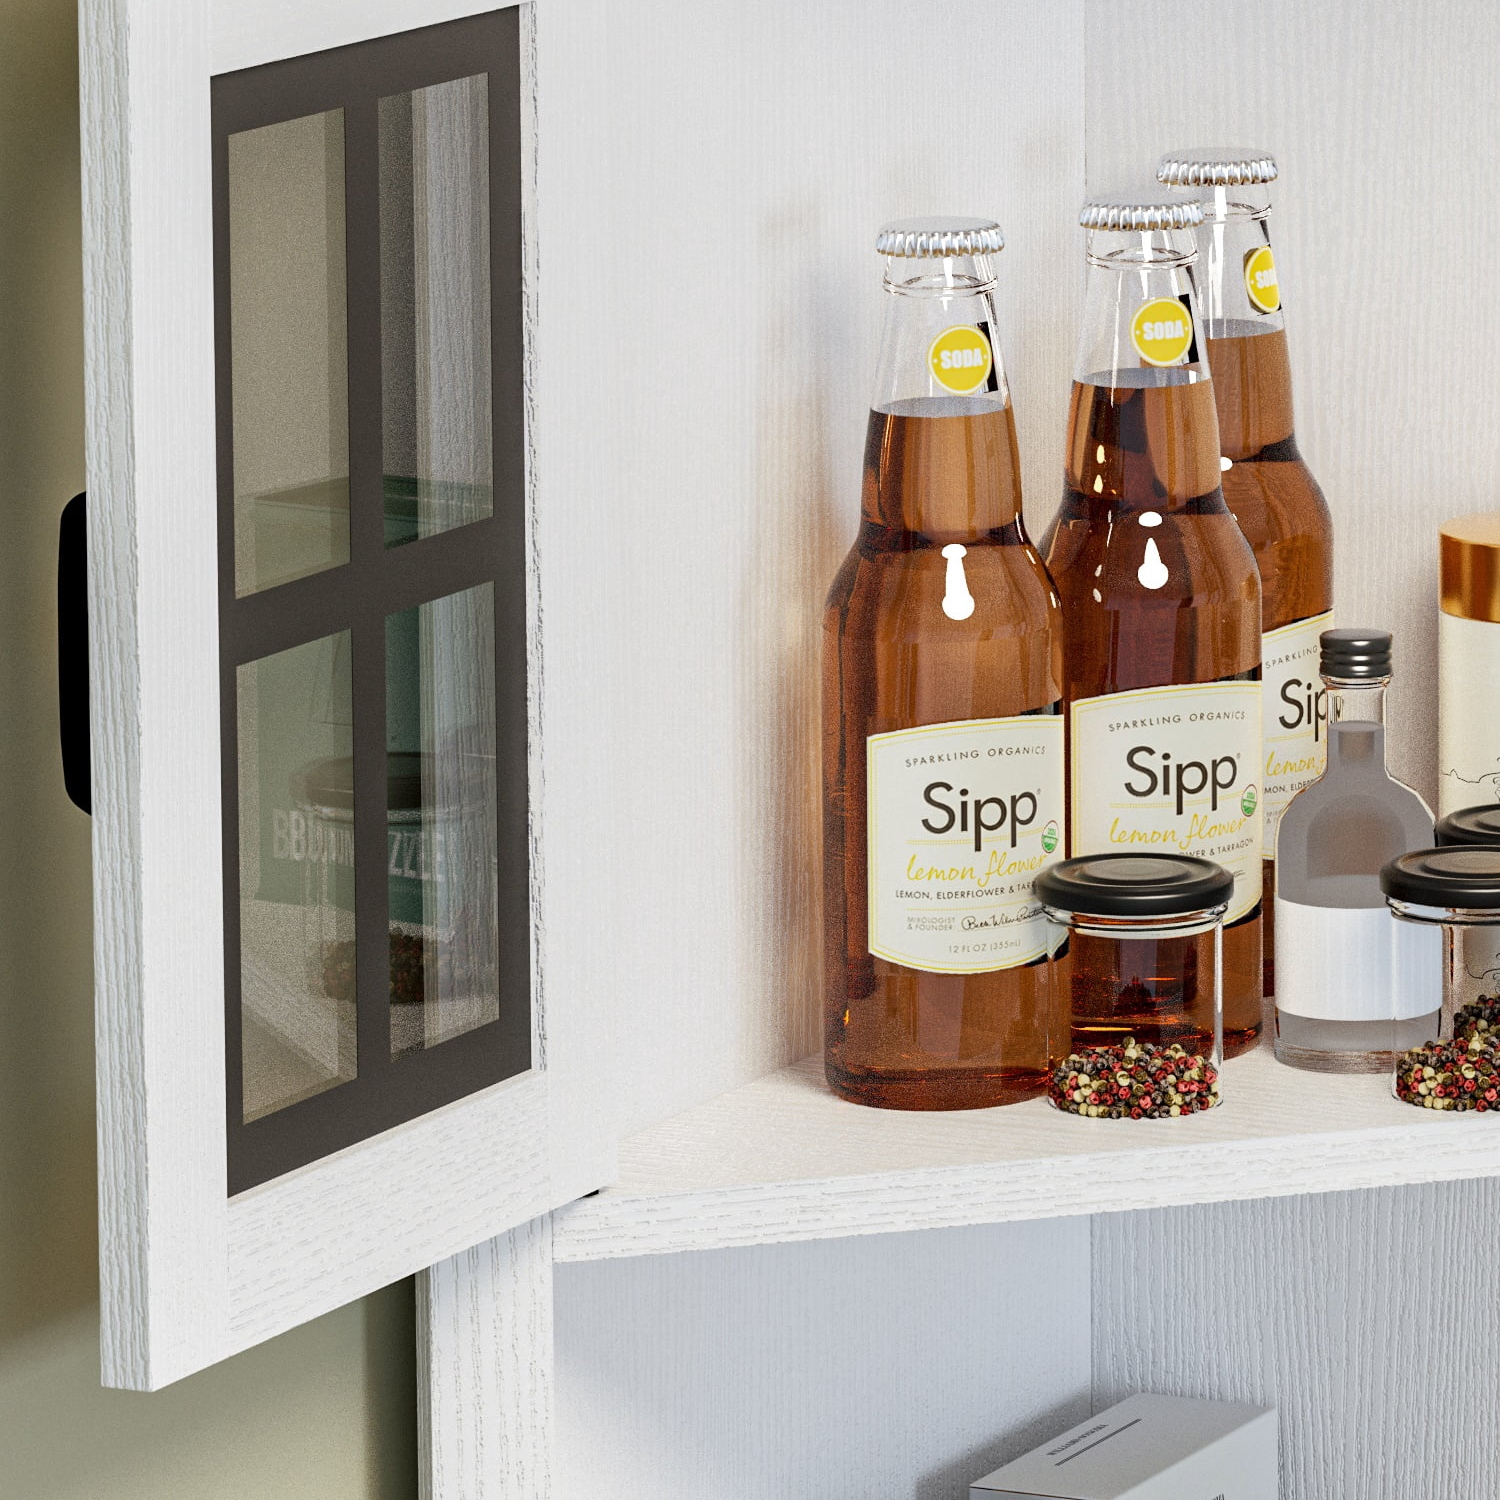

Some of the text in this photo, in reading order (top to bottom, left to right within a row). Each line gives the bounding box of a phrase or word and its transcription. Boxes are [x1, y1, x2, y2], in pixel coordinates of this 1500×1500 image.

[1142, 319, 1184, 341] SODA
[940, 347, 983, 369] SODA
[1265, 644, 1318, 670] SPARKLING
[1108, 710, 1246, 732] SPARKLING ORGANICS
[1278, 678, 1327, 743] Sip
[905, 745, 1047, 768] SPARKLING ORGANICS
[1265, 750, 1315, 777] lemon
[1124, 745, 1237, 816] Sipp
[921, 781, 1038, 853] Sipp
[1109, 817, 1178, 844] lemon
[1178, 813, 1247, 850] flower
[1209, 848, 1215, 856] &
[1217, 835, 1254, 853] TARRAGON
[906, 850, 1047, 888] lemon flower
[895, 886, 1015, 900] LEMON, ELDERFLOWER &
[948, 945, 959, 954] 12
[972, 943, 987, 952] OZ
